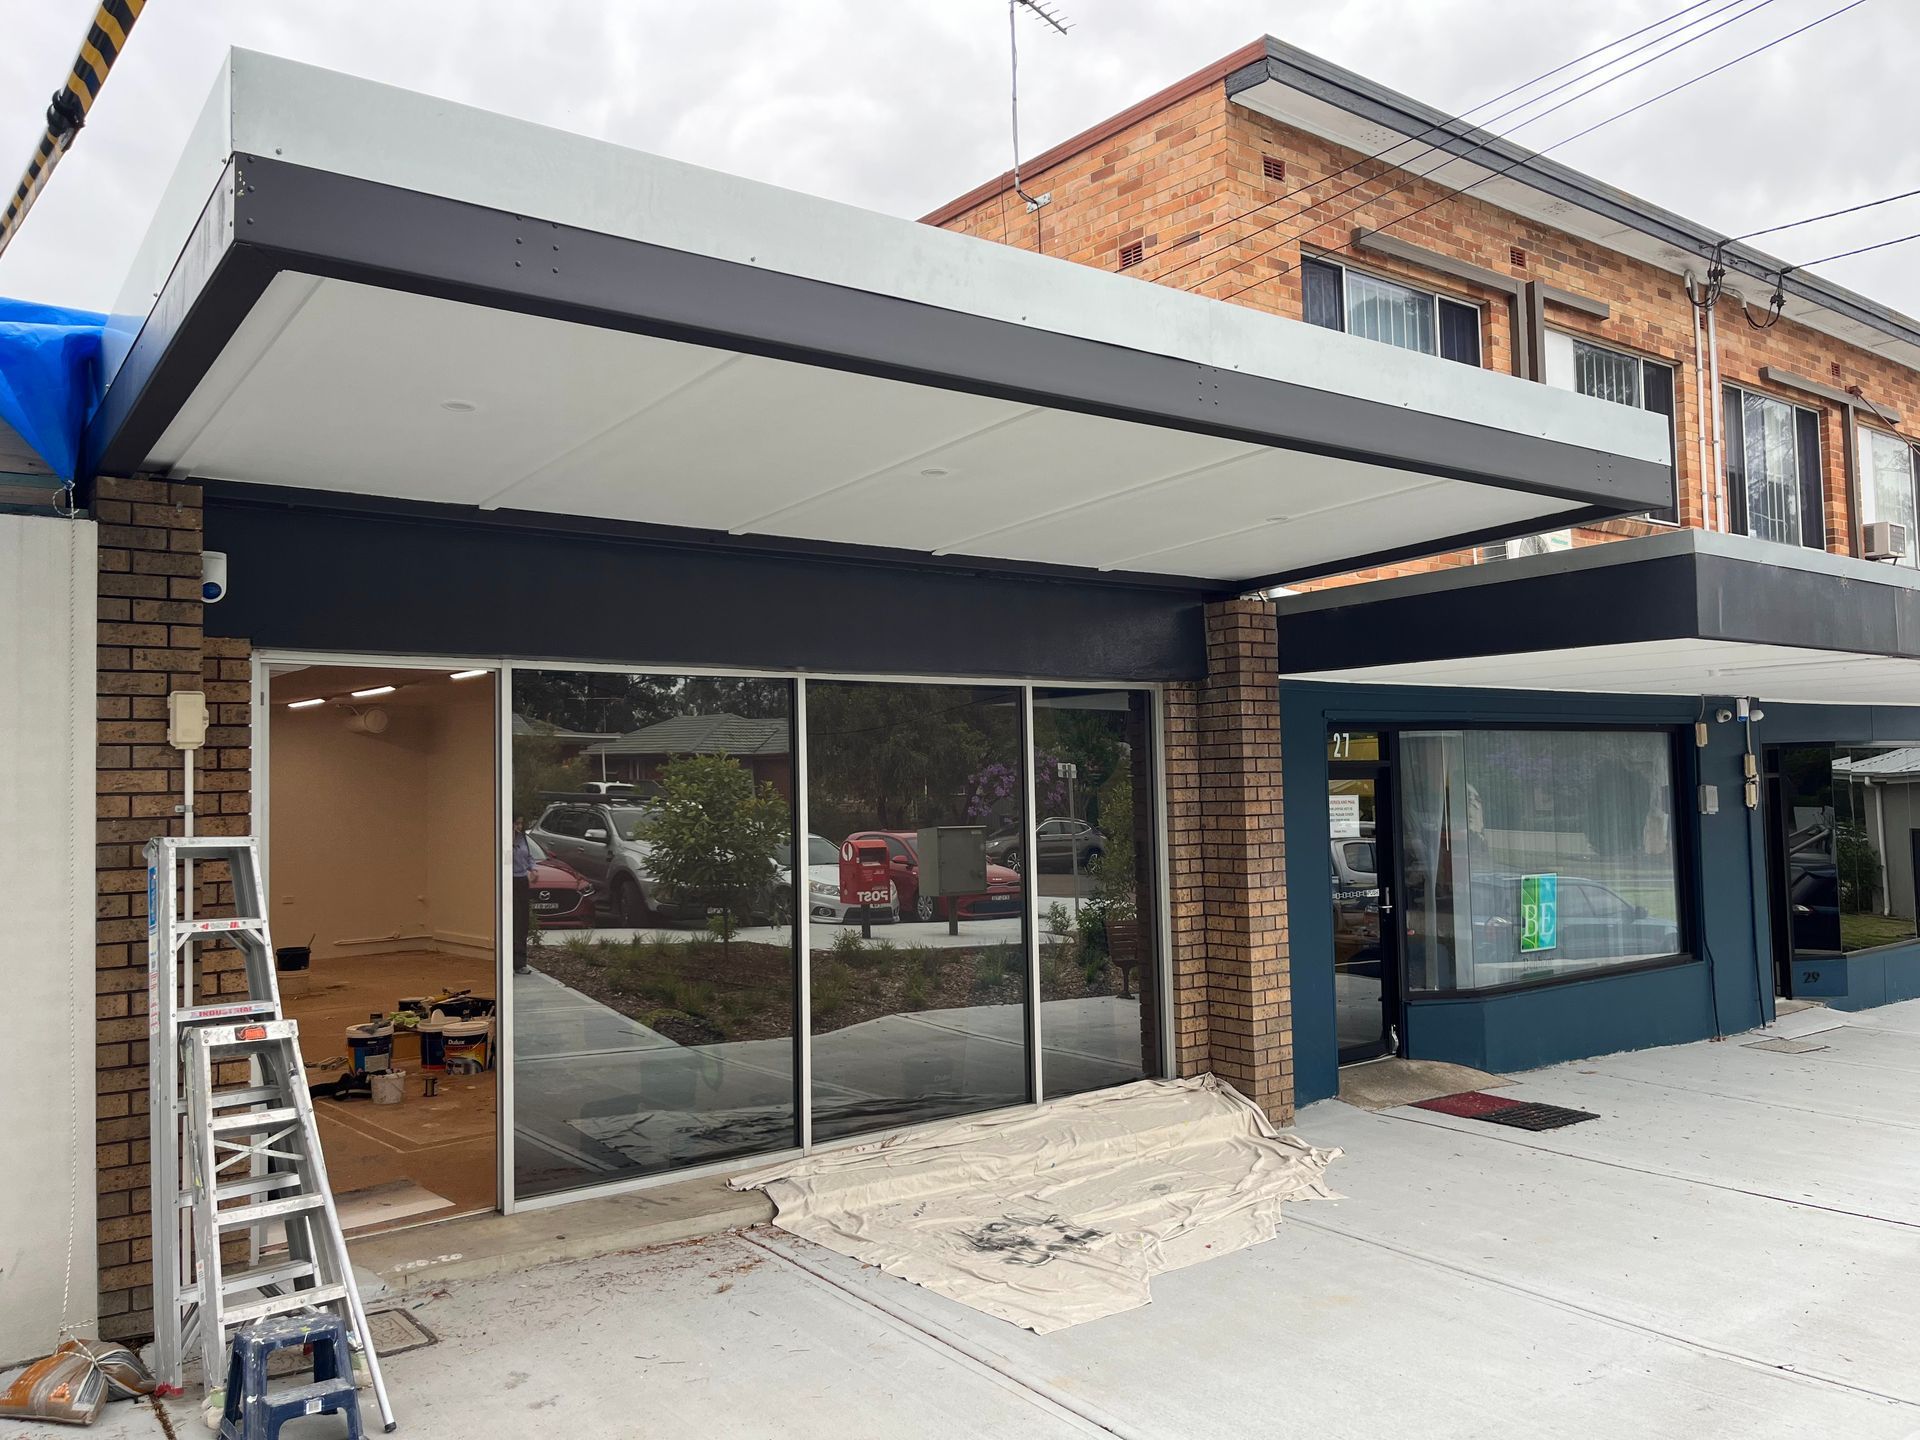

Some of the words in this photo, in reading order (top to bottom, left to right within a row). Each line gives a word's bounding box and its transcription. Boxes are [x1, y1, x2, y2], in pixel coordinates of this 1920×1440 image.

[1333, 732, 1350, 758] 27
[1523, 902, 1555, 937] BE
[1802, 971, 1820, 984] 29
